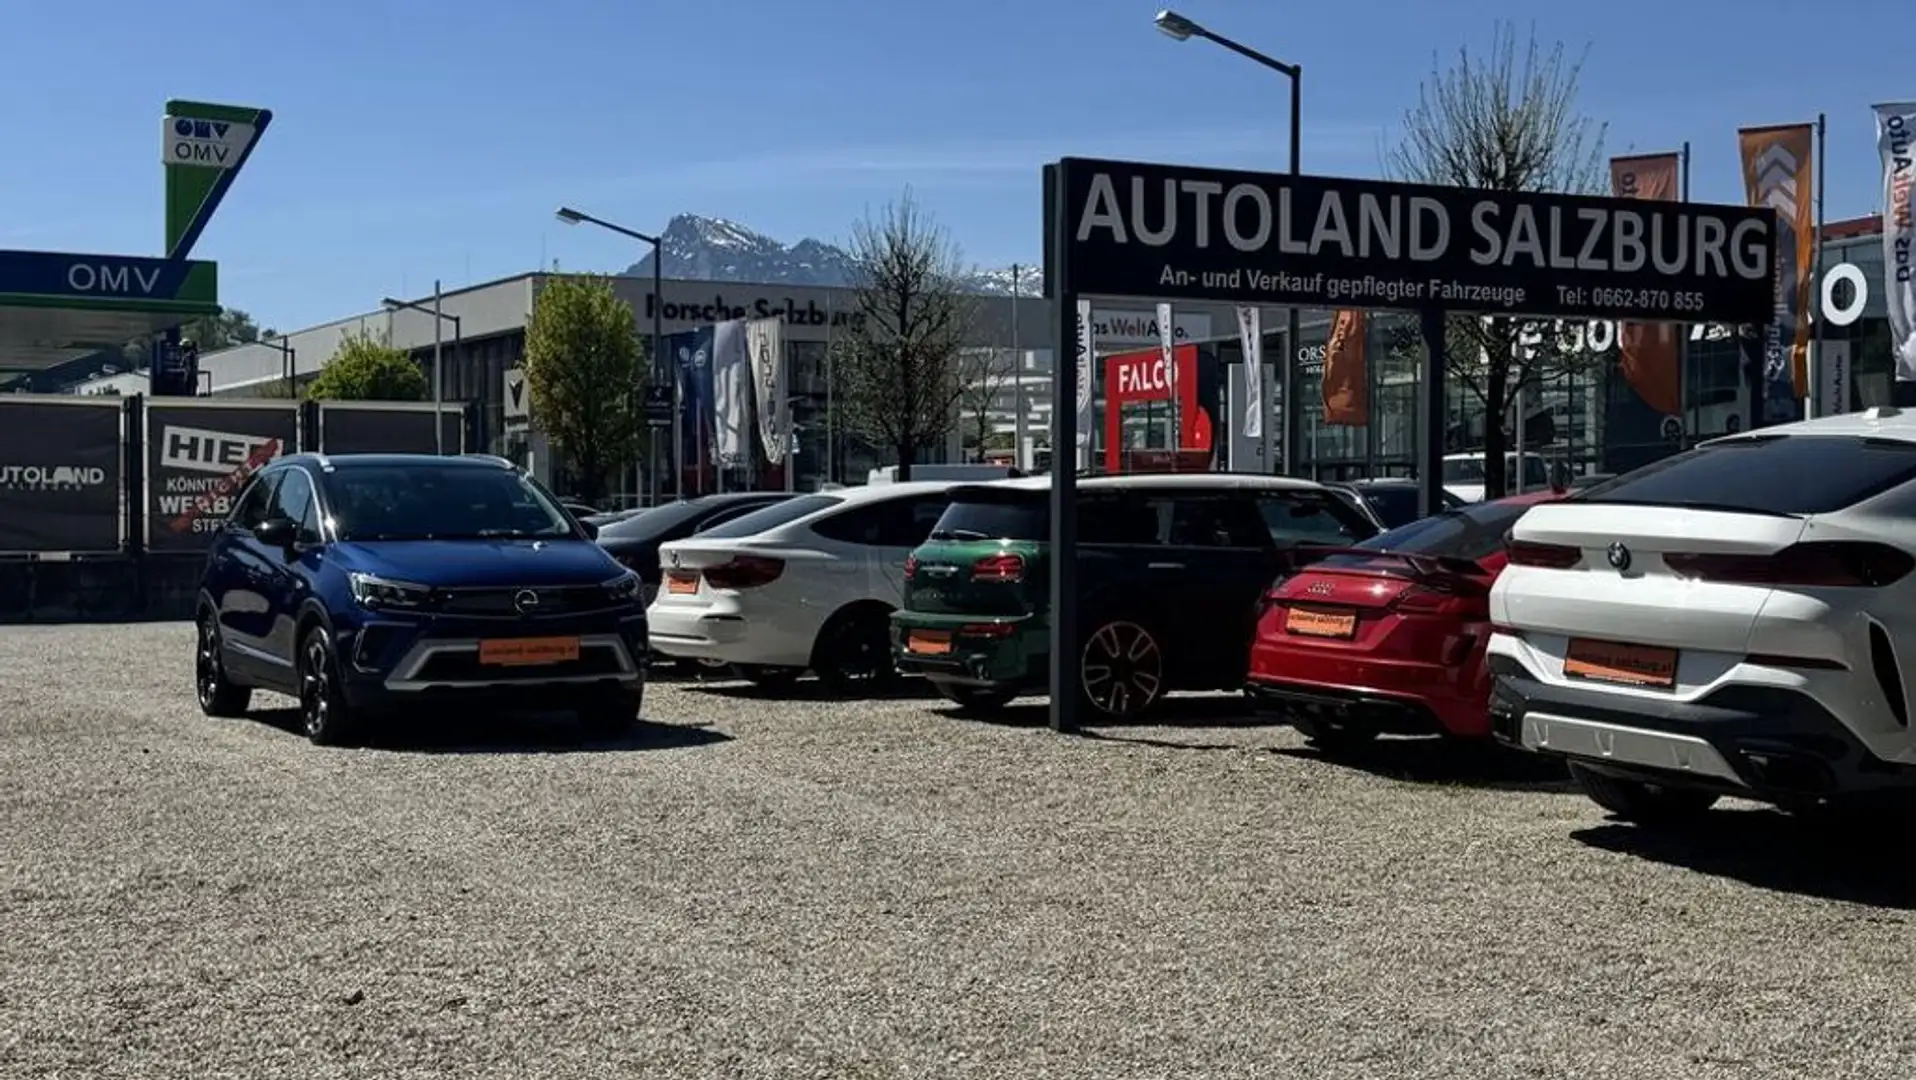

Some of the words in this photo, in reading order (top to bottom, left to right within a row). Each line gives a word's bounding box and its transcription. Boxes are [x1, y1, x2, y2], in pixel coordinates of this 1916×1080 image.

[175, 142, 229, 163] OMV
[1076, 173, 1451, 261] AUTOLAND
[1470, 200, 1768, 279] SALZBURG
[68, 263, 160, 293] OMV
[1160, 264, 1197, 286] An-
[1202, 268, 1240, 288] und
[1246, 269, 1324, 293] Verkauf
[1327, 275, 1424, 301] gepflegter
[1430, 280, 1525, 306] Fahrzeuge
[1557, 286, 1587, 306] Tel:
[1592, 288, 1669, 309] 0662-870
[1675, 291, 1704, 310] 855
[1110, 316, 1189, 339] WeltAo.
[0, 466, 104, 484] UTOLAND
[166, 475, 219, 492] KÖNNT
